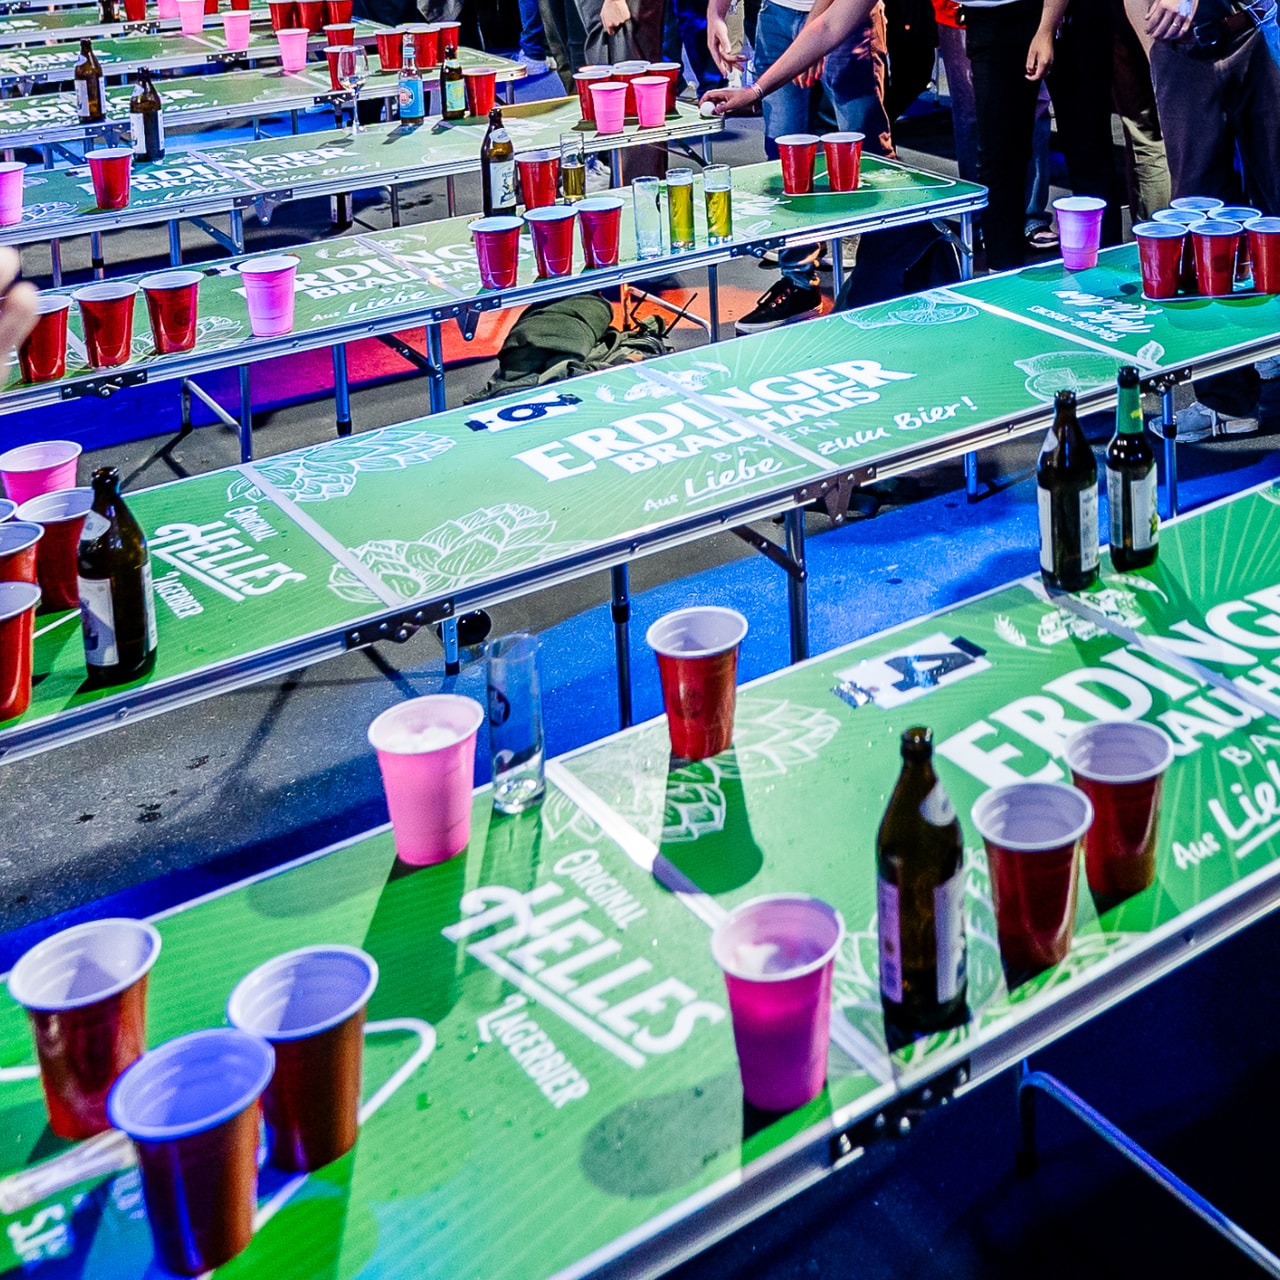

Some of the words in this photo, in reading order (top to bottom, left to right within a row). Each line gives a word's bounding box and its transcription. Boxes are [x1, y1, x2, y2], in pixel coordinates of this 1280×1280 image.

[231, 233, 535, 300] RDING
[345, 289, 431, 314] Liebe
[511, 359, 918, 483] ERDINGER
[610, 387, 882, 474] BRAUHAUS
[643, 494, 680, 512] Aus
[683, 457, 785, 501] Liebe
[816, 425, 892, 456] zum
[147, 520, 308, 597] HELLES
[885, 651, 976, 693] 4
[553, 848, 648, 930] ORIGINAL
[1171, 831, 1220, 871] Aus
[441, 881, 726, 1054] HELLES
[476, 992, 590, 1109] LAGERBIER
